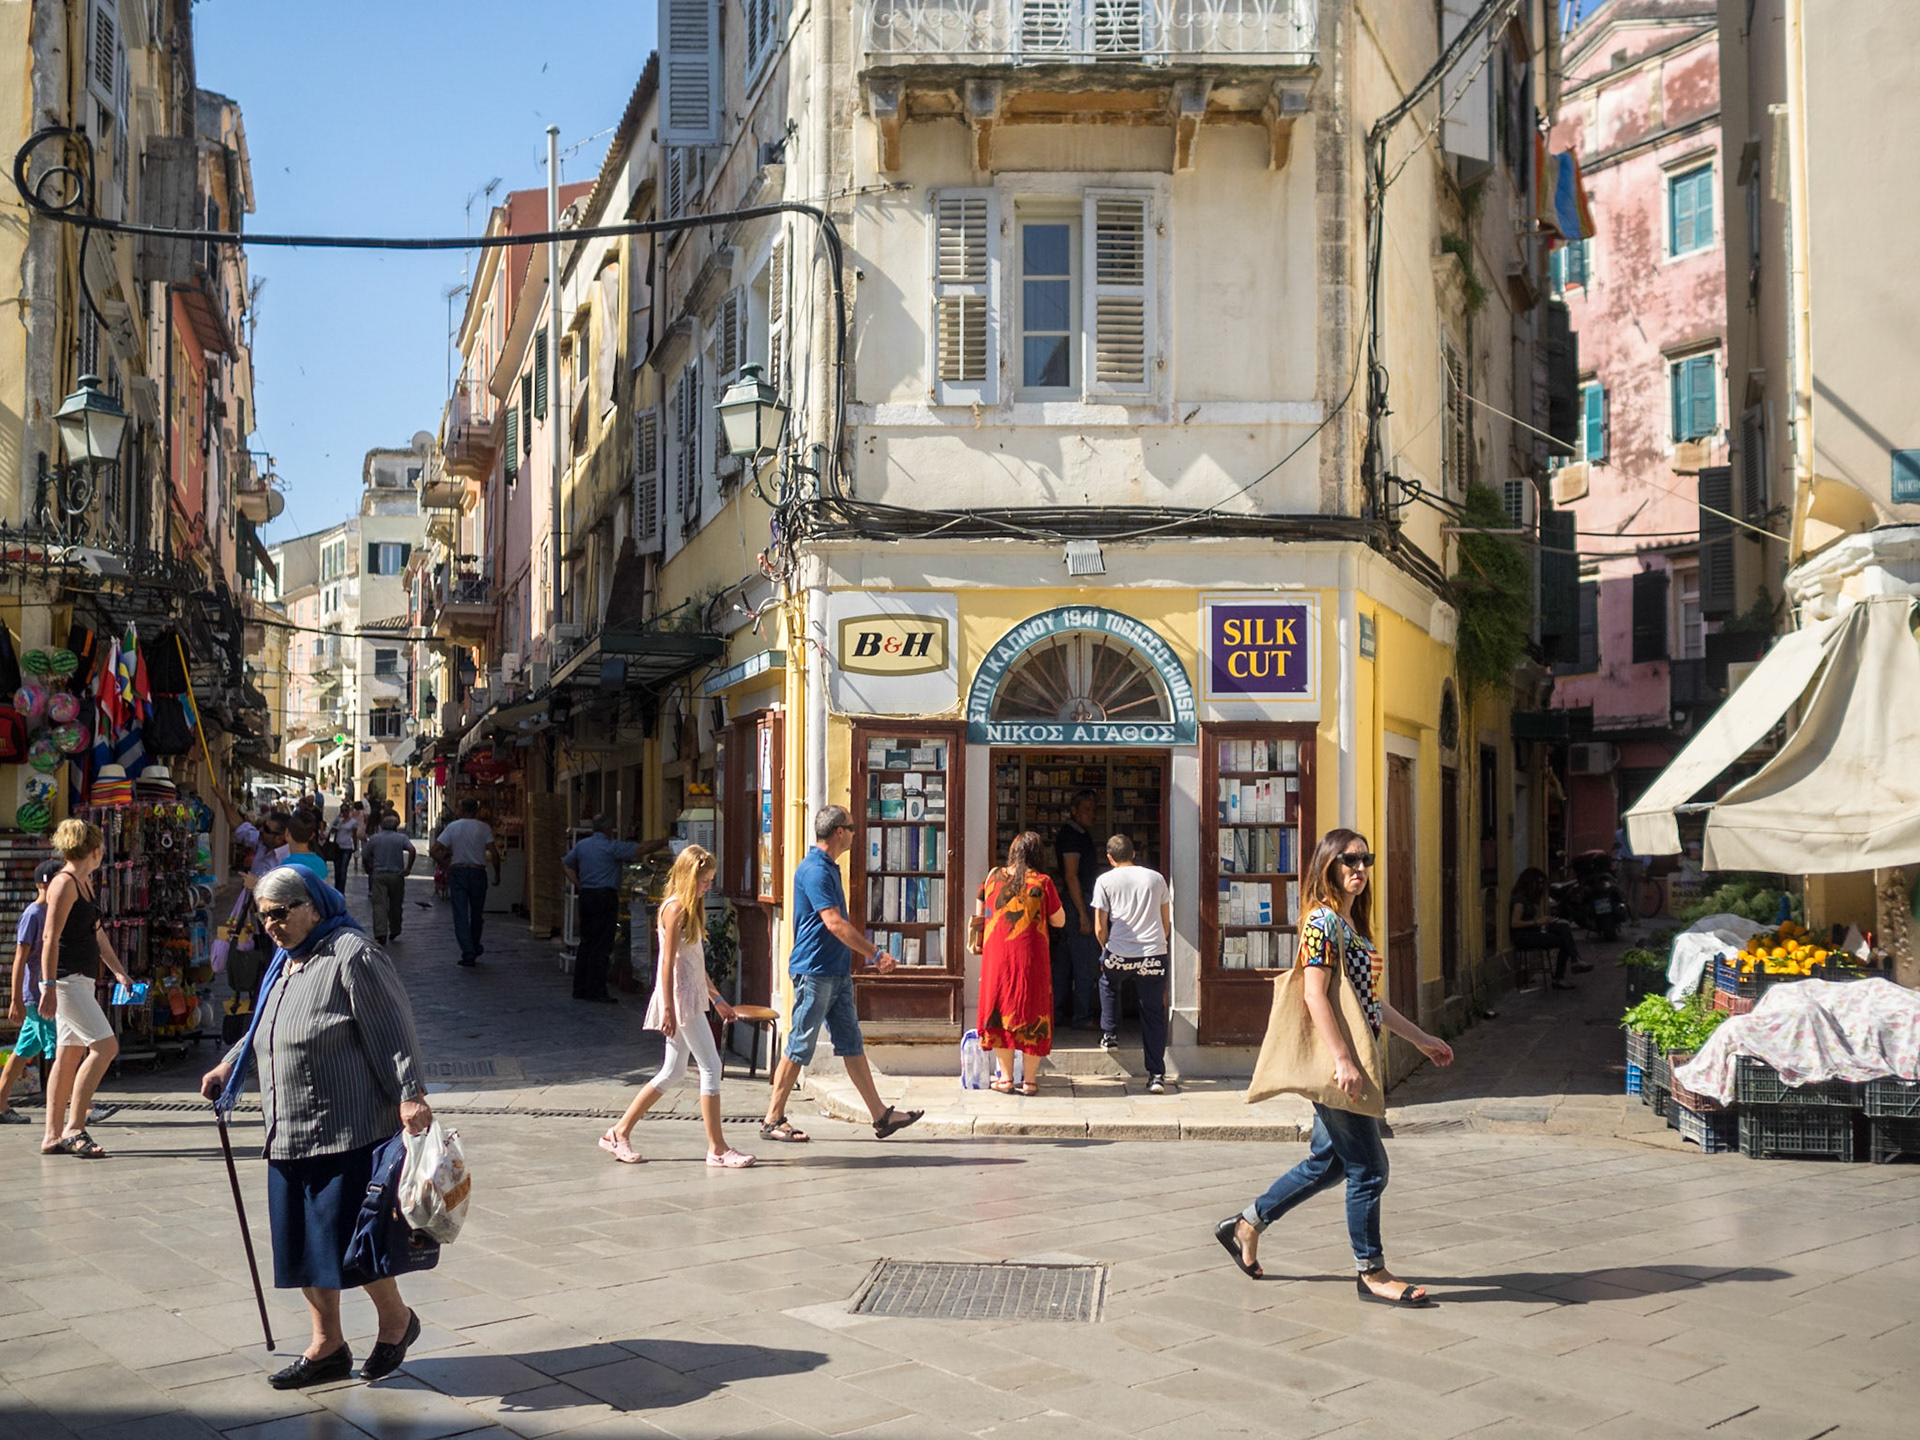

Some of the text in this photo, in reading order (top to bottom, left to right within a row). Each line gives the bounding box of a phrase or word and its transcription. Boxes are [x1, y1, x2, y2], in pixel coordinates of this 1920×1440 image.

[851, 632, 935, 657] B&H
[1223, 618, 1298, 646] SILK
[969, 673, 995, 724] ΣΠΙΤΙ
[985, 613, 1055, 673] ΚΑΠΝΟΥ
[1062, 609, 1099, 627] 1941
[1227, 650, 1292, 678] CUT
[986, 725, 1175, 741] ΝΙΚΟΣ ΑΓΑΘΟΣ
[1104, 953, 1162, 971] Frankie
